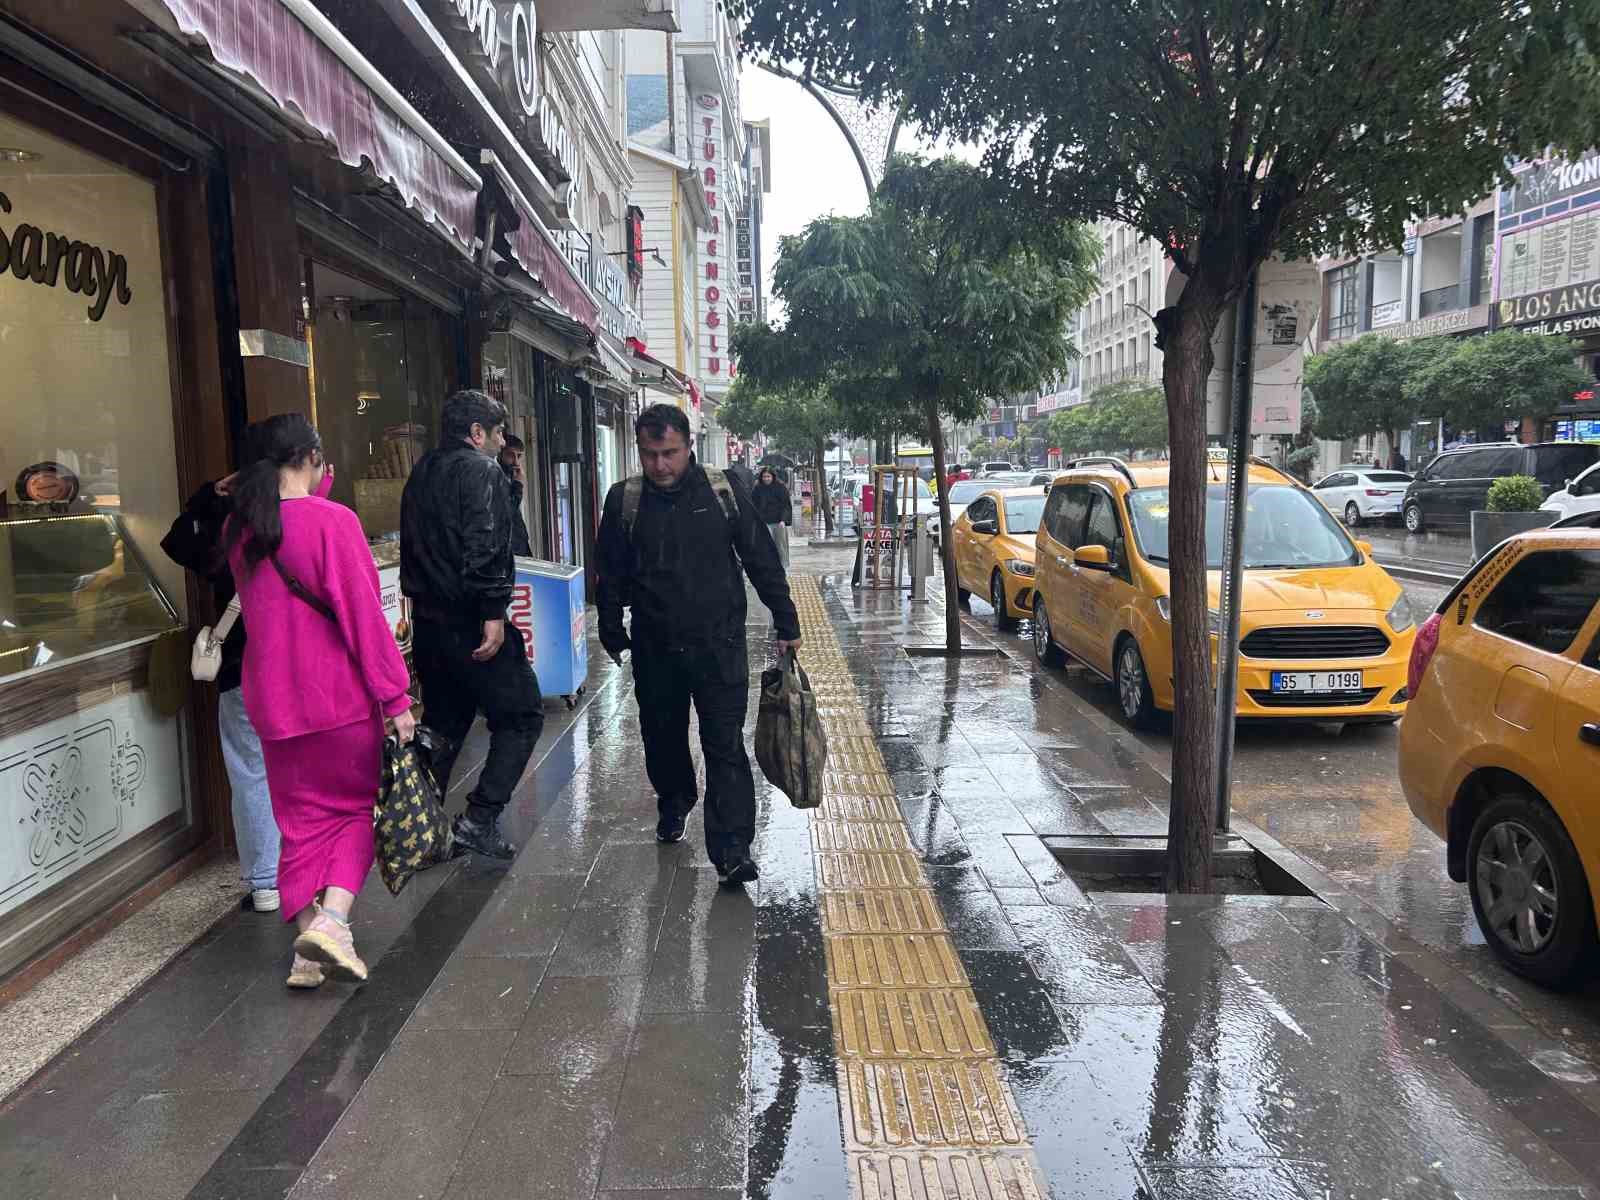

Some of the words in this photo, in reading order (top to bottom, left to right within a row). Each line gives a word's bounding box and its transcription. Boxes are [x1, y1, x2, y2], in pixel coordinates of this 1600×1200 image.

[1514, 293, 1552, 321] LOS
[1281, 675, 1297, 689] 65
[1308, 674, 1316, 689] T
[1327, 673, 1360, 688] 0199
